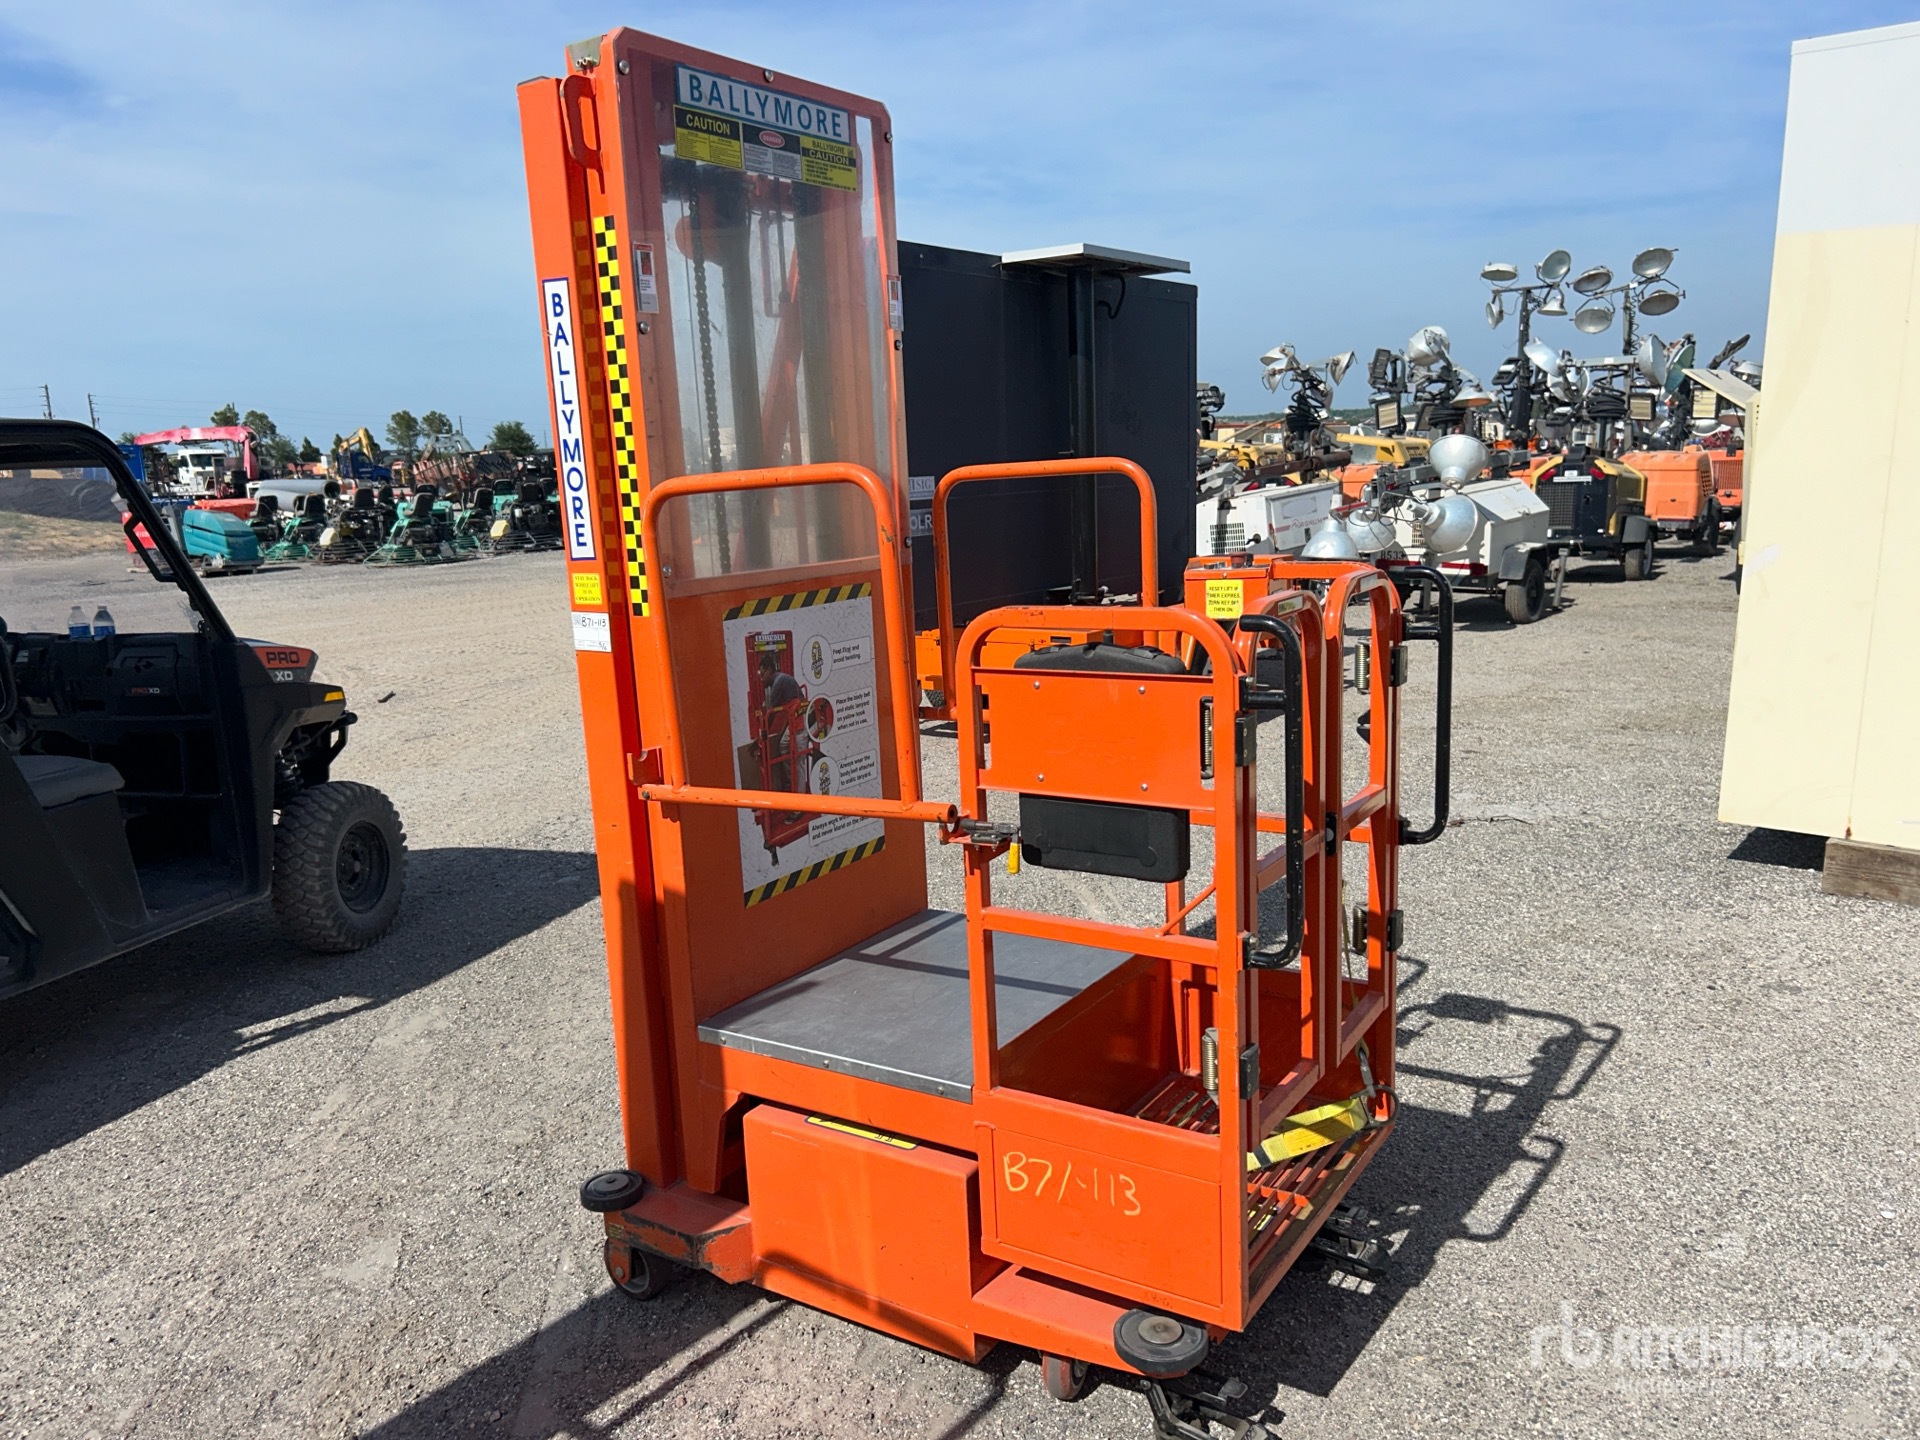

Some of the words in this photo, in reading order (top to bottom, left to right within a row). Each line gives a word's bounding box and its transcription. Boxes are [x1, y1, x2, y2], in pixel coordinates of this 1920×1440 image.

[689, 73, 842, 138] BALLYMORE
[686, 113, 730, 135] CAUTION
[812, 140, 845, 154] BALLYMORE
[810, 150, 849, 165] CAUTION
[551, 293, 587, 547] BALLYMORE
[581, 616, 607, 628] B71-113
[265, 651, 299, 664] PRO
[275, 671, 293, 681] XD
[843, 713, 854, 721] yellow
[840, 760, 853, 769] Always
[812, 822, 827, 831] Always
[828, 817, 838, 825] work
[812, 832, 821, 840] and
[1003, 1151, 1142, 1216] B71-113
